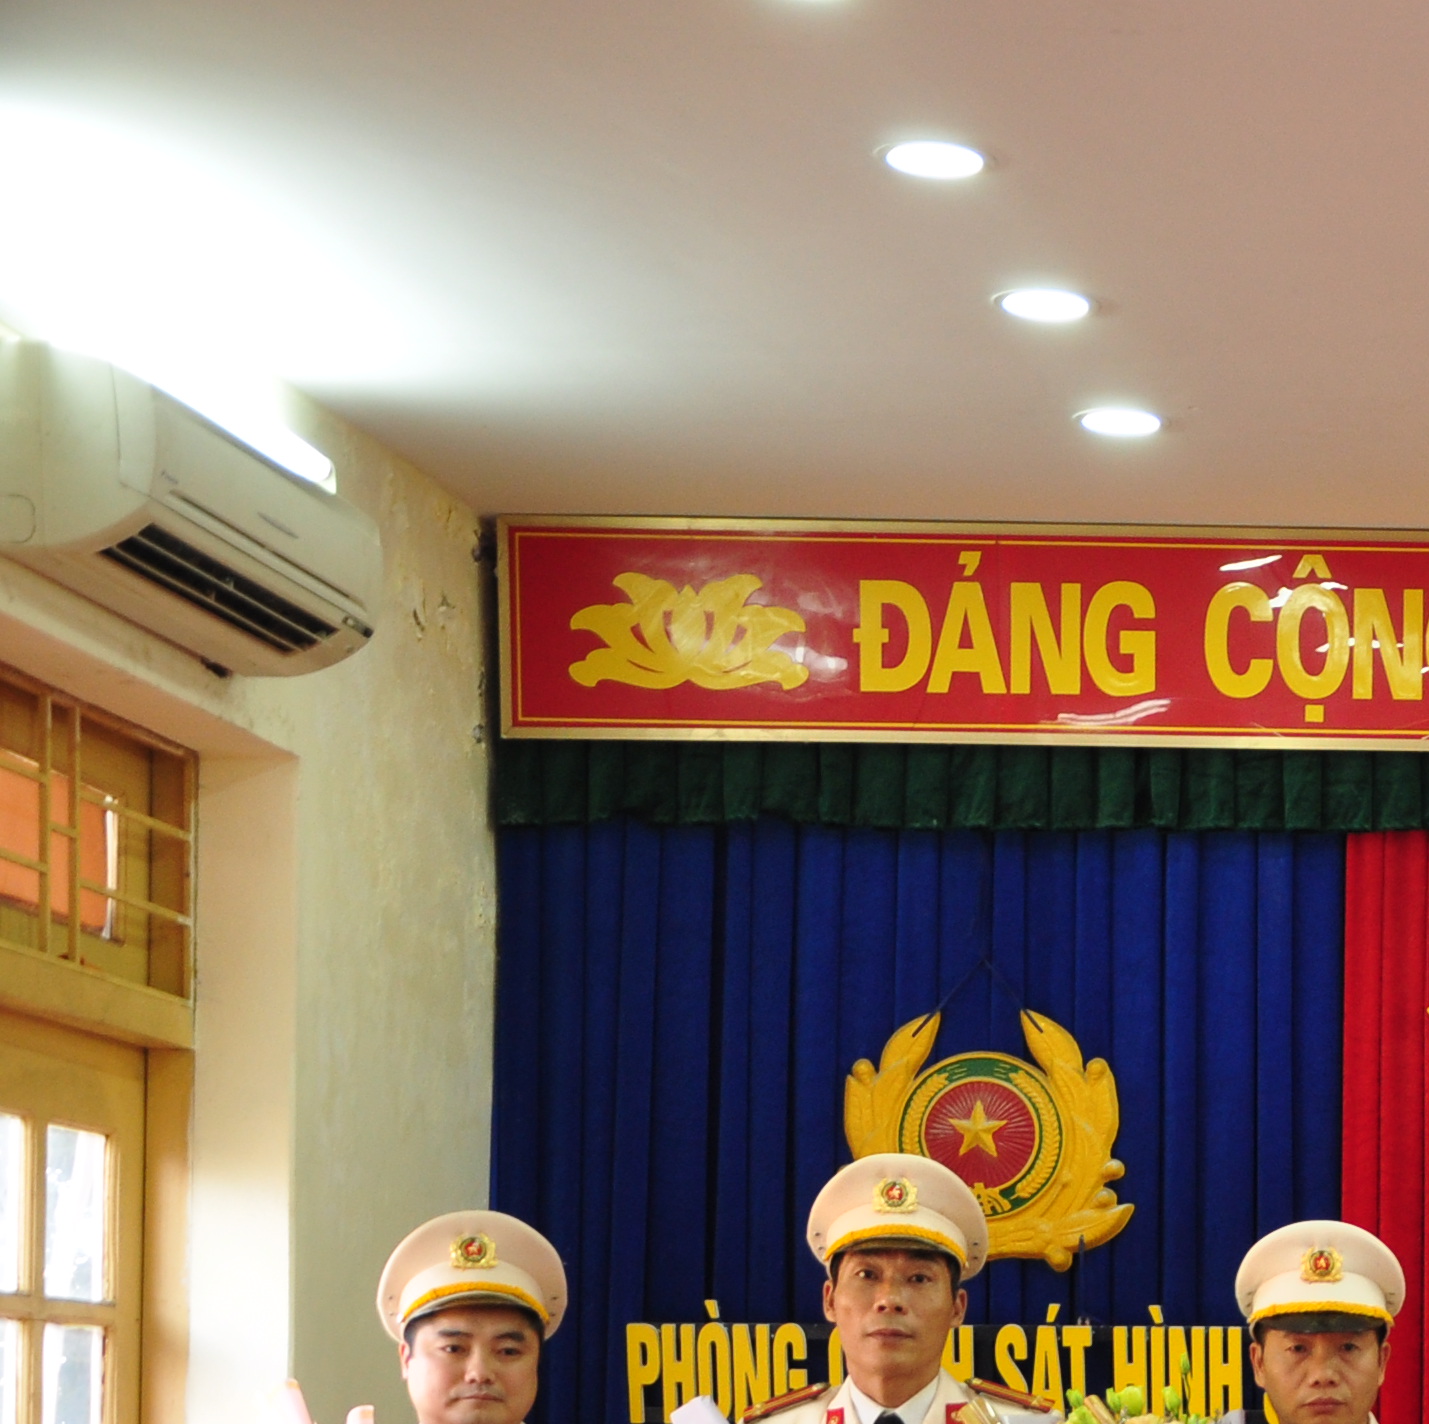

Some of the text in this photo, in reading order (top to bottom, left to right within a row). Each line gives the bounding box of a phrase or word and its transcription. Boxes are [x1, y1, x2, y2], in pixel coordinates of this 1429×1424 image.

[853, 551, 1156, 697] ĐẢNG
[626, 1299, 808, 1424] PHÒNG
[994, 1303, 1093, 1419] SÁT
[1112, 1305, 1244, 1419] HÌNH
